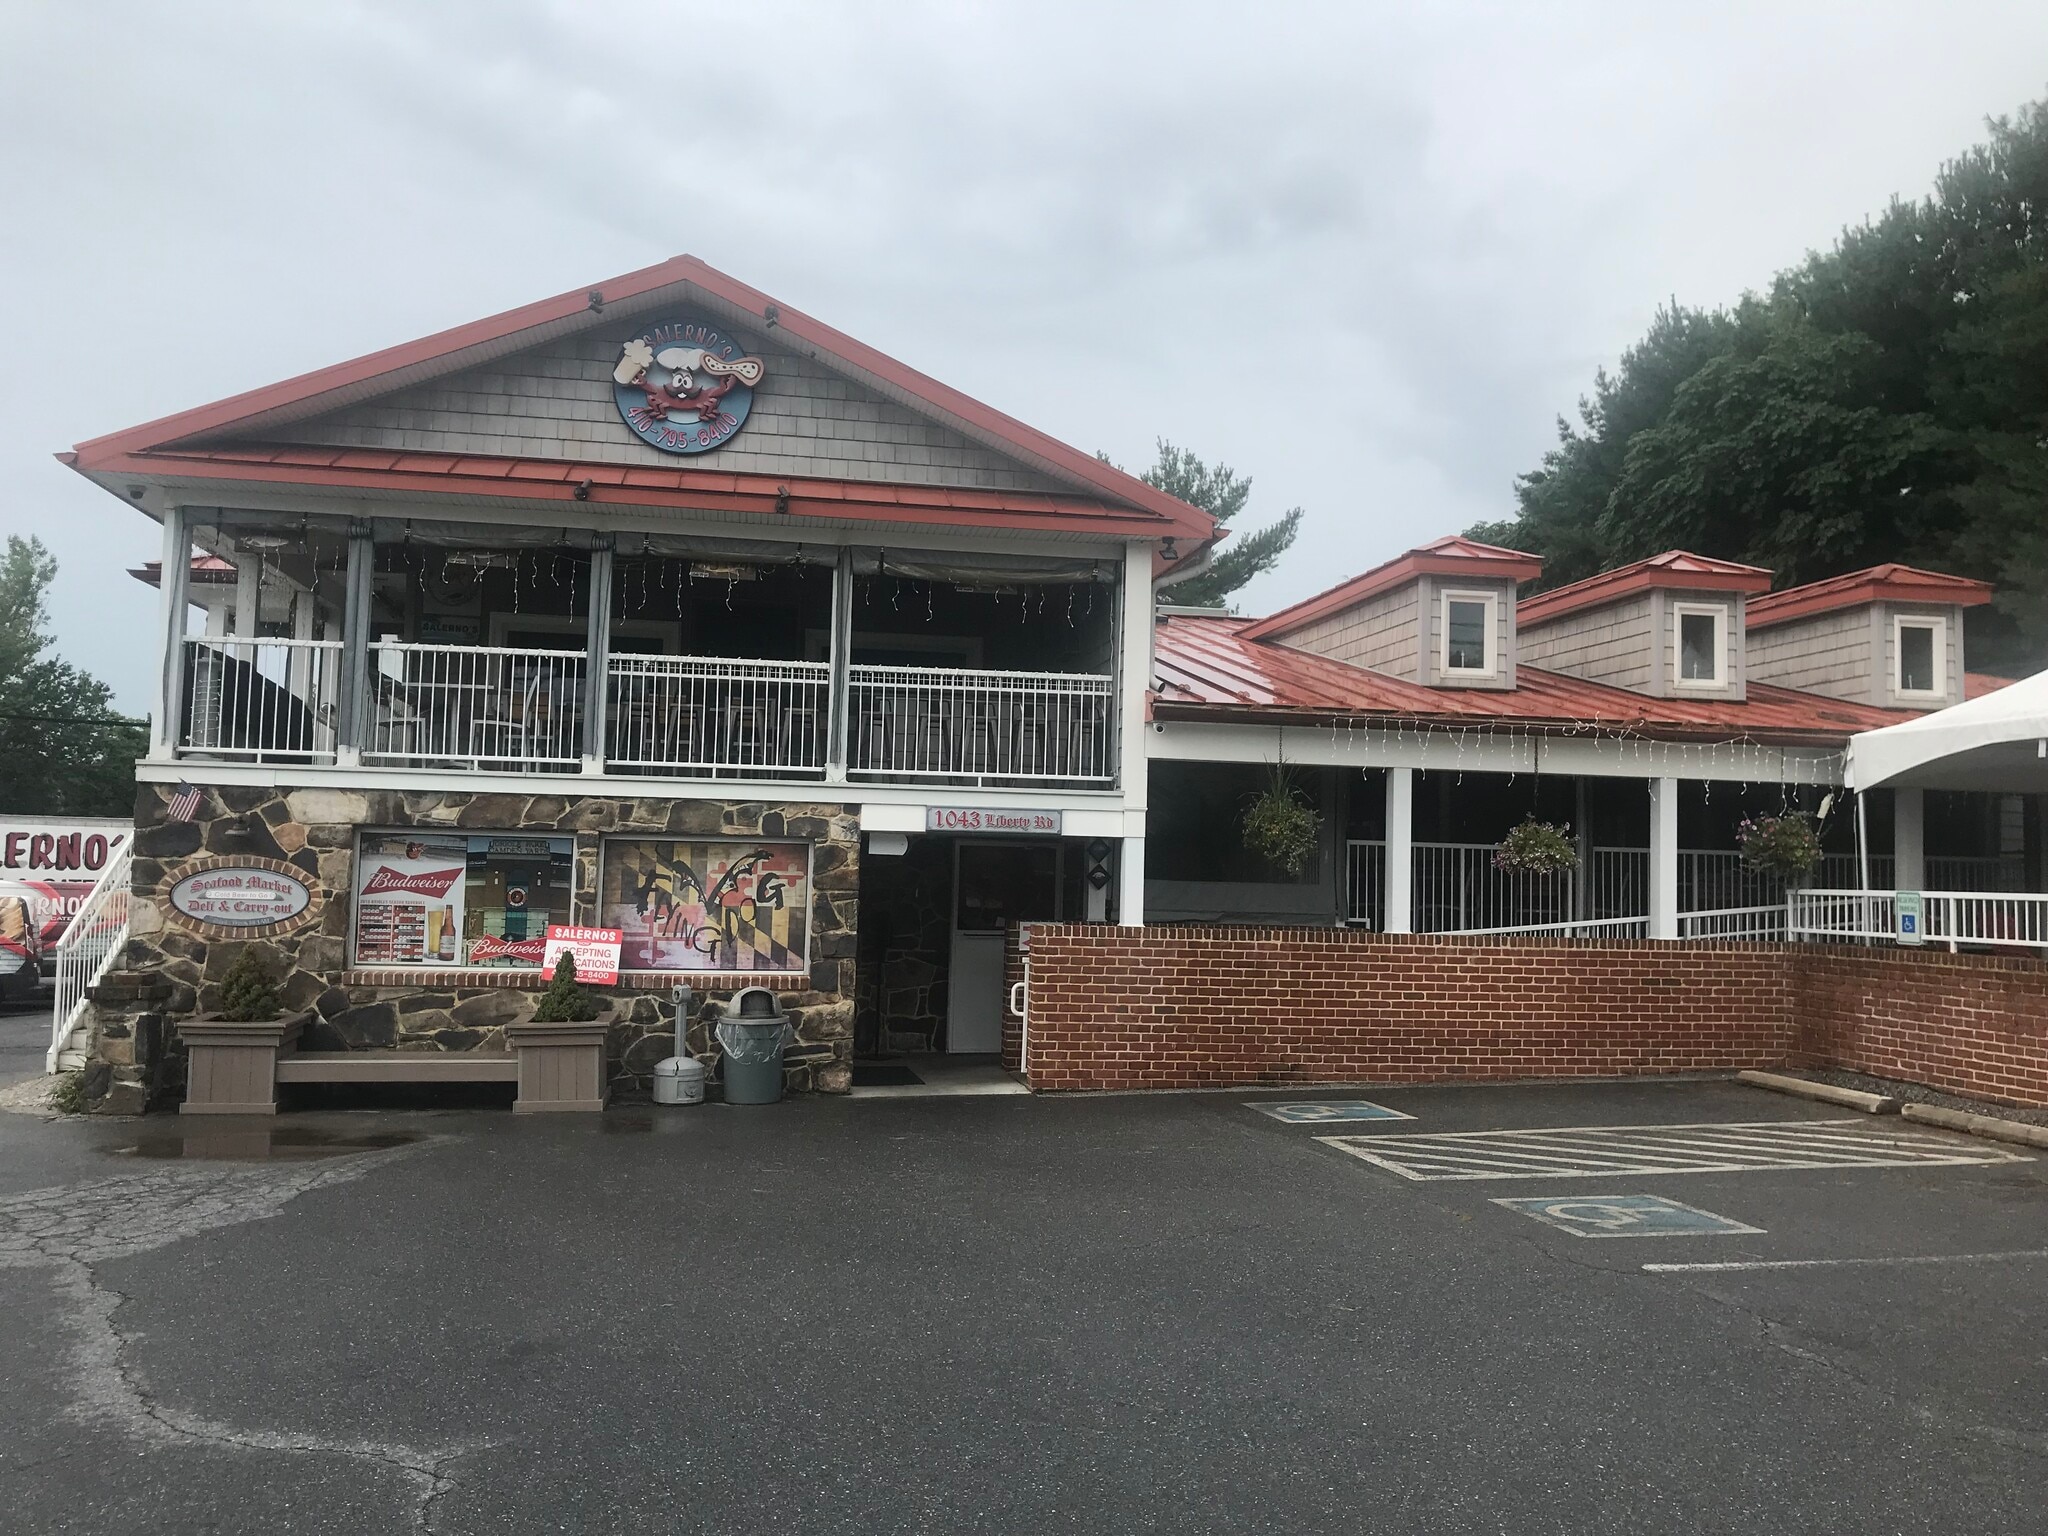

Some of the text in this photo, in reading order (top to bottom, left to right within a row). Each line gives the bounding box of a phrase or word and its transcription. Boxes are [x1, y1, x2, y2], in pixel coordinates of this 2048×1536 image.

[643, 323, 733, 360] SALERNO'S
[628, 406, 738, 449] 410-795-8400
[422, 622, 479, 634] SALERNO'S
[935, 809, 1055, 831] 1043 Liberty Rd
[0, 831, 131, 871] ERNO'
[190, 875, 293, 895] Seafood Market
[369, 872, 454, 889] Budweiser
[188, 900, 293, 915] Deli & Carry-out
[554, 927, 616, 942] SALERNOS
[466, 939, 547, 955] Budweise
[555, 946, 612, 958] ACCEPTING
[548, 956, 616, 970] APCATIONS
